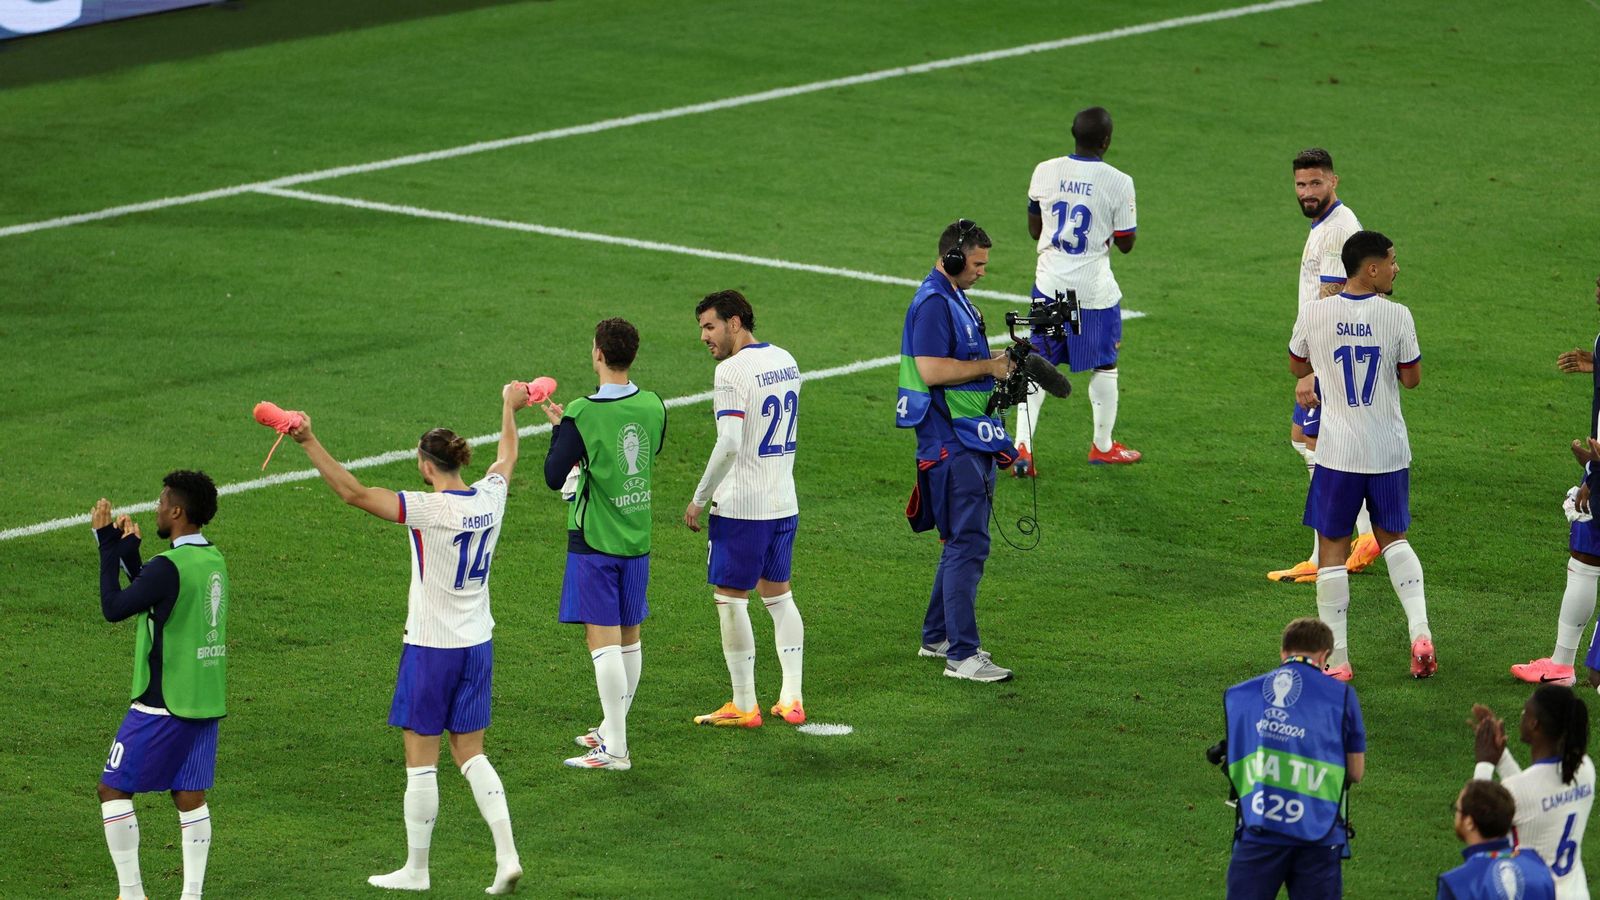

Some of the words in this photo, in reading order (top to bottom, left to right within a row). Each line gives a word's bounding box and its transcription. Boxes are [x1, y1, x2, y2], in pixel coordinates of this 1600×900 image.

[1060, 180, 1093, 196] KANTE
[1052, 201, 1092, 255] 13
[1336, 322, 1373, 337] SALIBA
[1333, 345, 1381, 407] 17
[758, 390, 798, 458] 22
[896, 395, 909, 419] 4
[462, 512, 494, 529] RABIOT
[452, 526, 495, 590] 14
[1288, 759, 1329, 792] TV
[1251, 790, 1305, 824] 629
[1551, 813, 1577, 878] 6
